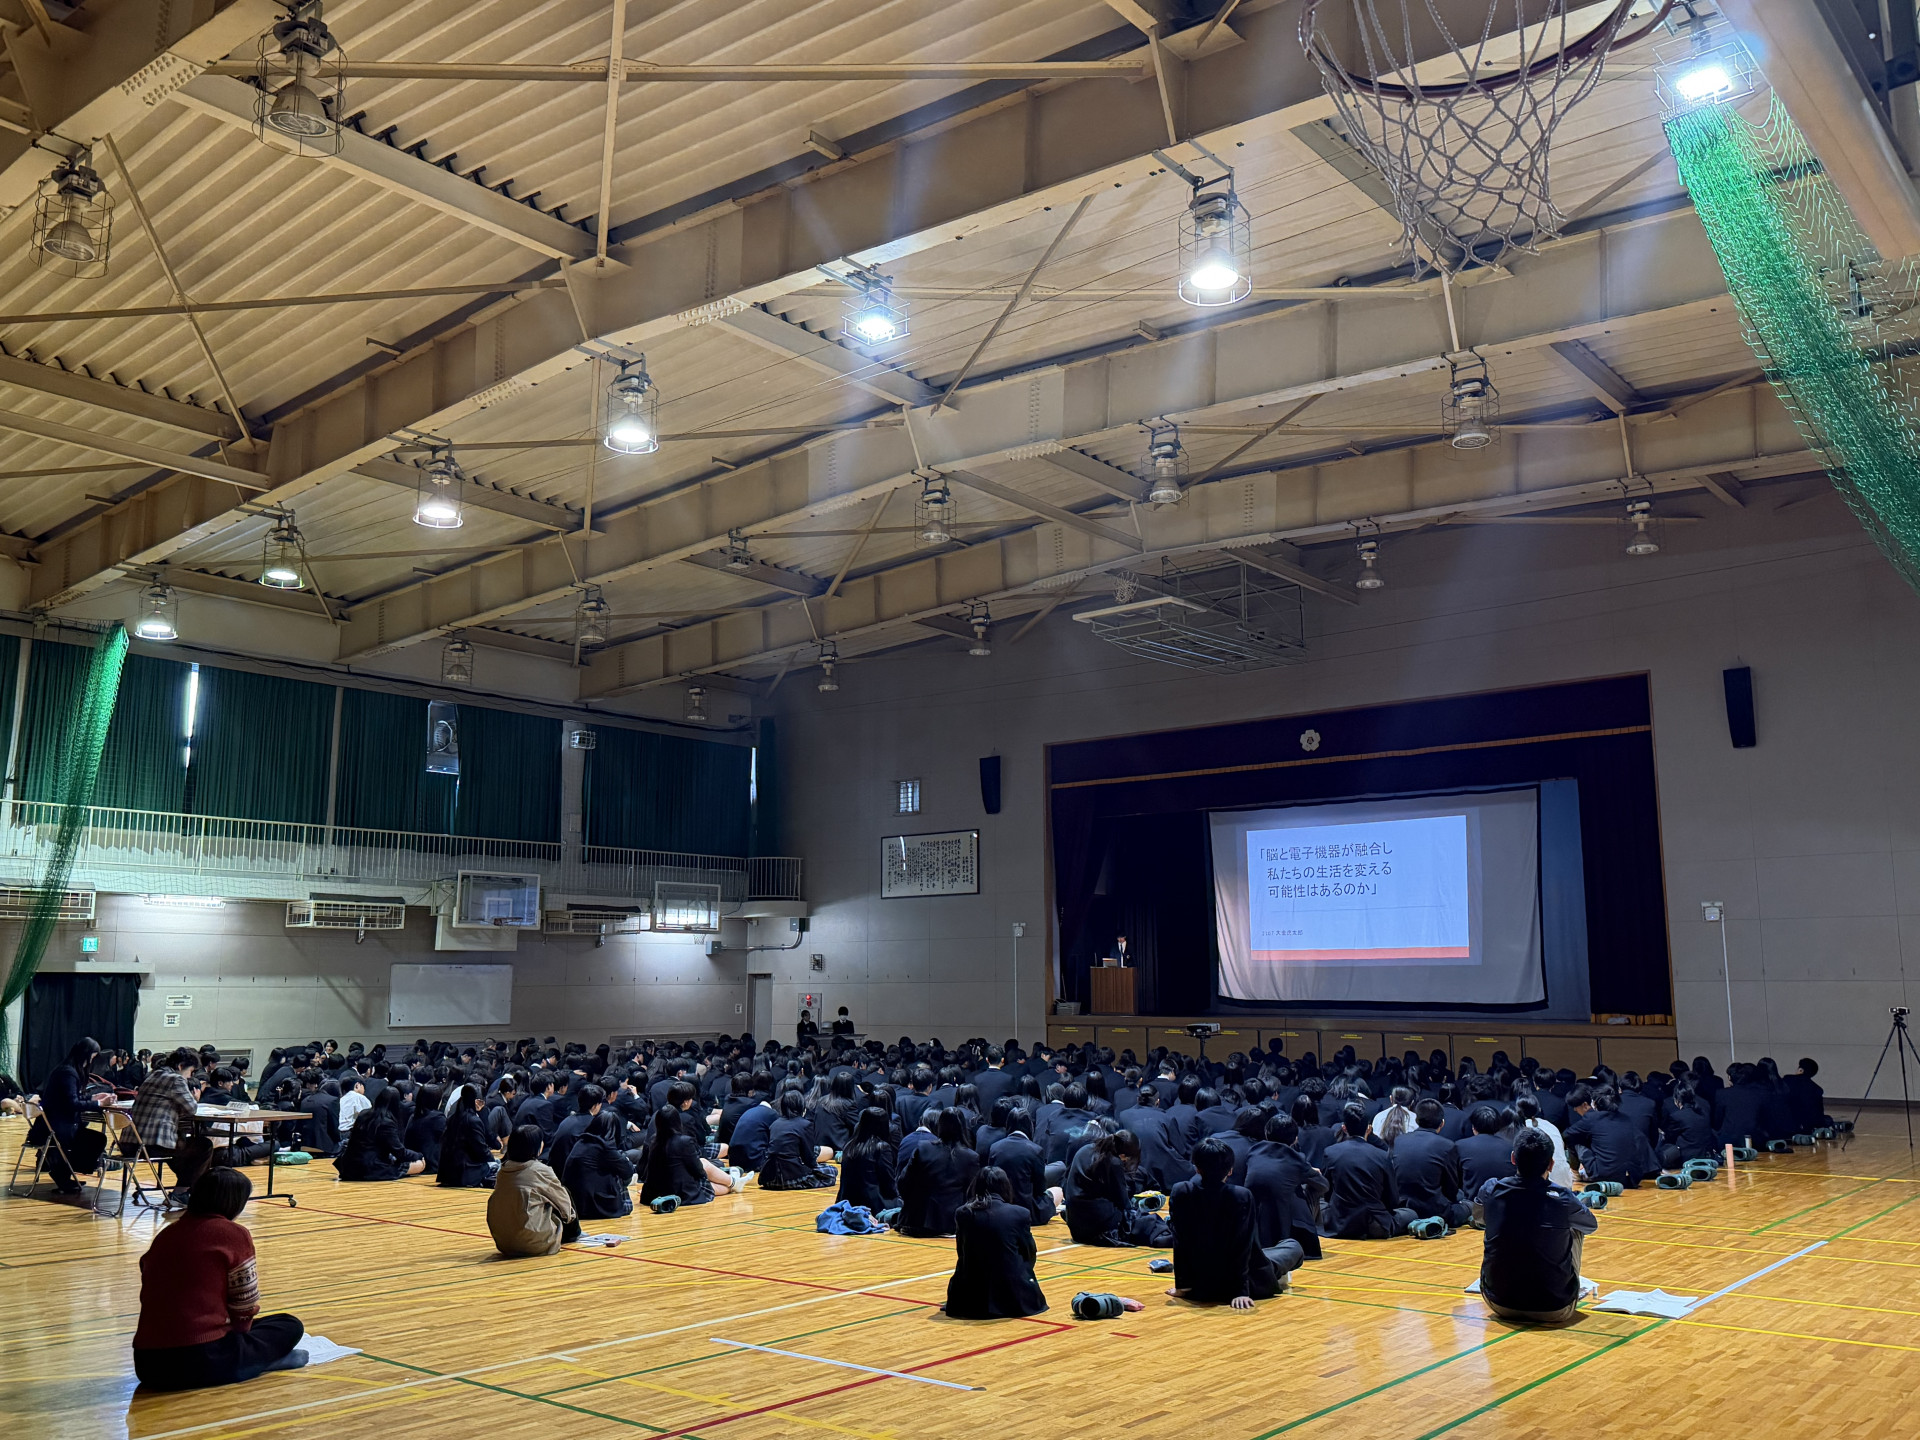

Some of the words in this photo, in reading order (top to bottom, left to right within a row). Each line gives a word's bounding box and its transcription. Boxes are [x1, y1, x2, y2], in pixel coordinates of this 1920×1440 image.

[1260, 841, 1393, 861] 「脳と電子機器が融合し
[1267, 861, 1392, 880] 私たちの生活を変える
[1268, 882, 1377, 898] 可能性はあるのか」
